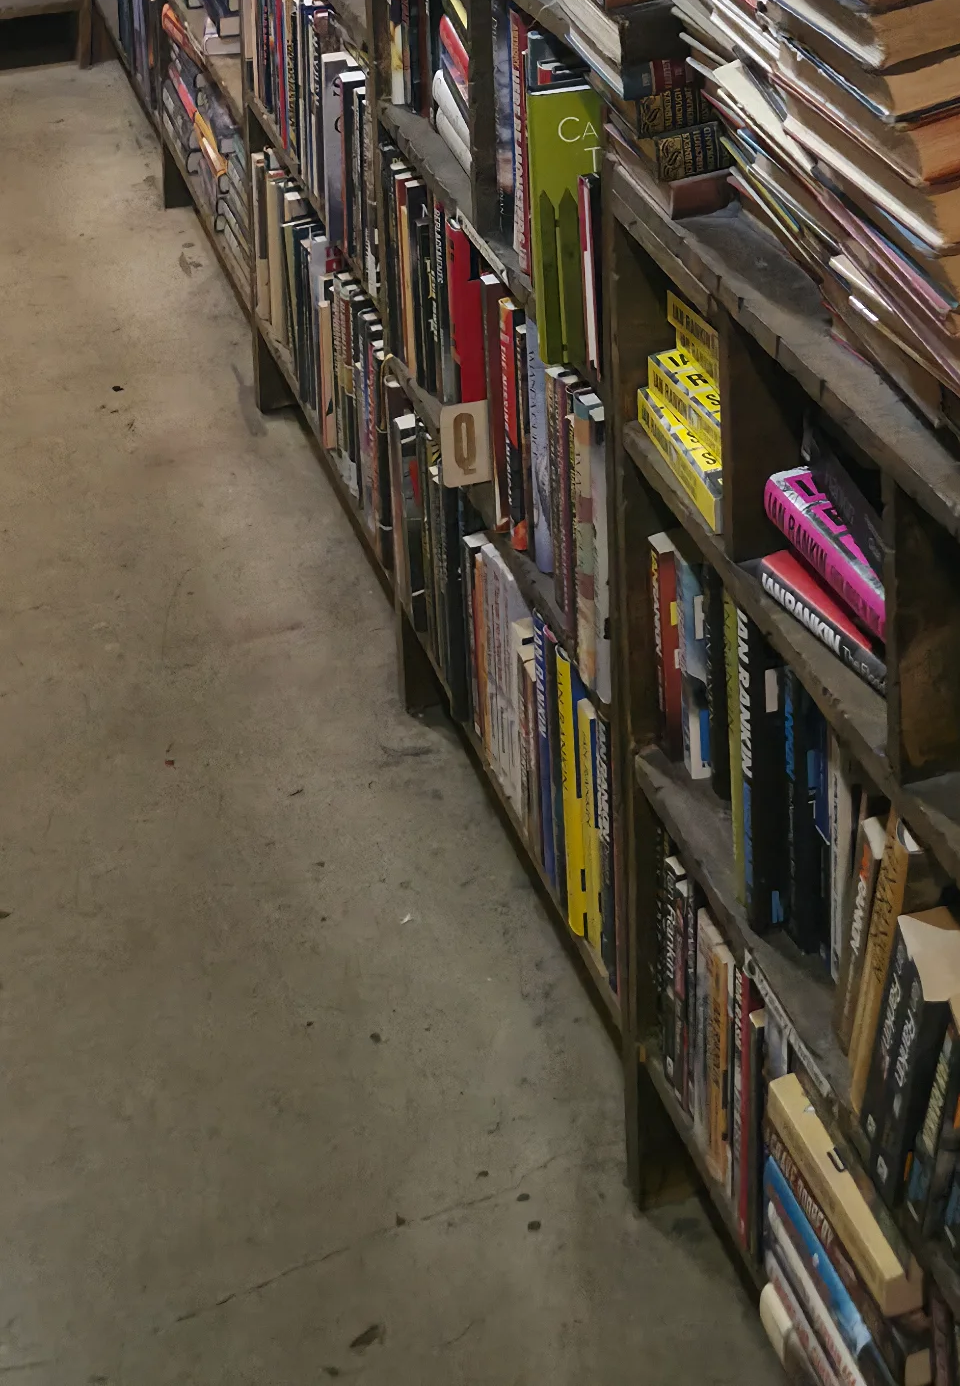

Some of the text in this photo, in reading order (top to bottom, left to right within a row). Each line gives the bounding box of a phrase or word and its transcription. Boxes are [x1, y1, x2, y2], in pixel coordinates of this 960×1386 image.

[557, 117, 599, 143] CA
[434, 208, 444, 284] REPLACEMENTS
[453, 412, 477, 475] Q
[500, 346, 513, 506] THE MISSING AMERICAN
[650, 549, 659, 586] IAN
[767, 492, 828, 575] IAN RANKIN
[652, 587, 663, 659] RANKIN
[534, 623, 548, 739] IAN RANKIN
[736, 608, 753, 779] IAN RANKIN
[557, 669, 569, 795] IAN RANKIN
[595, 715, 611, 851] IAN RANKIN
[663, 870, 676, 981] Ian Rankin
[894, 1007, 918, 1089] Rankin
